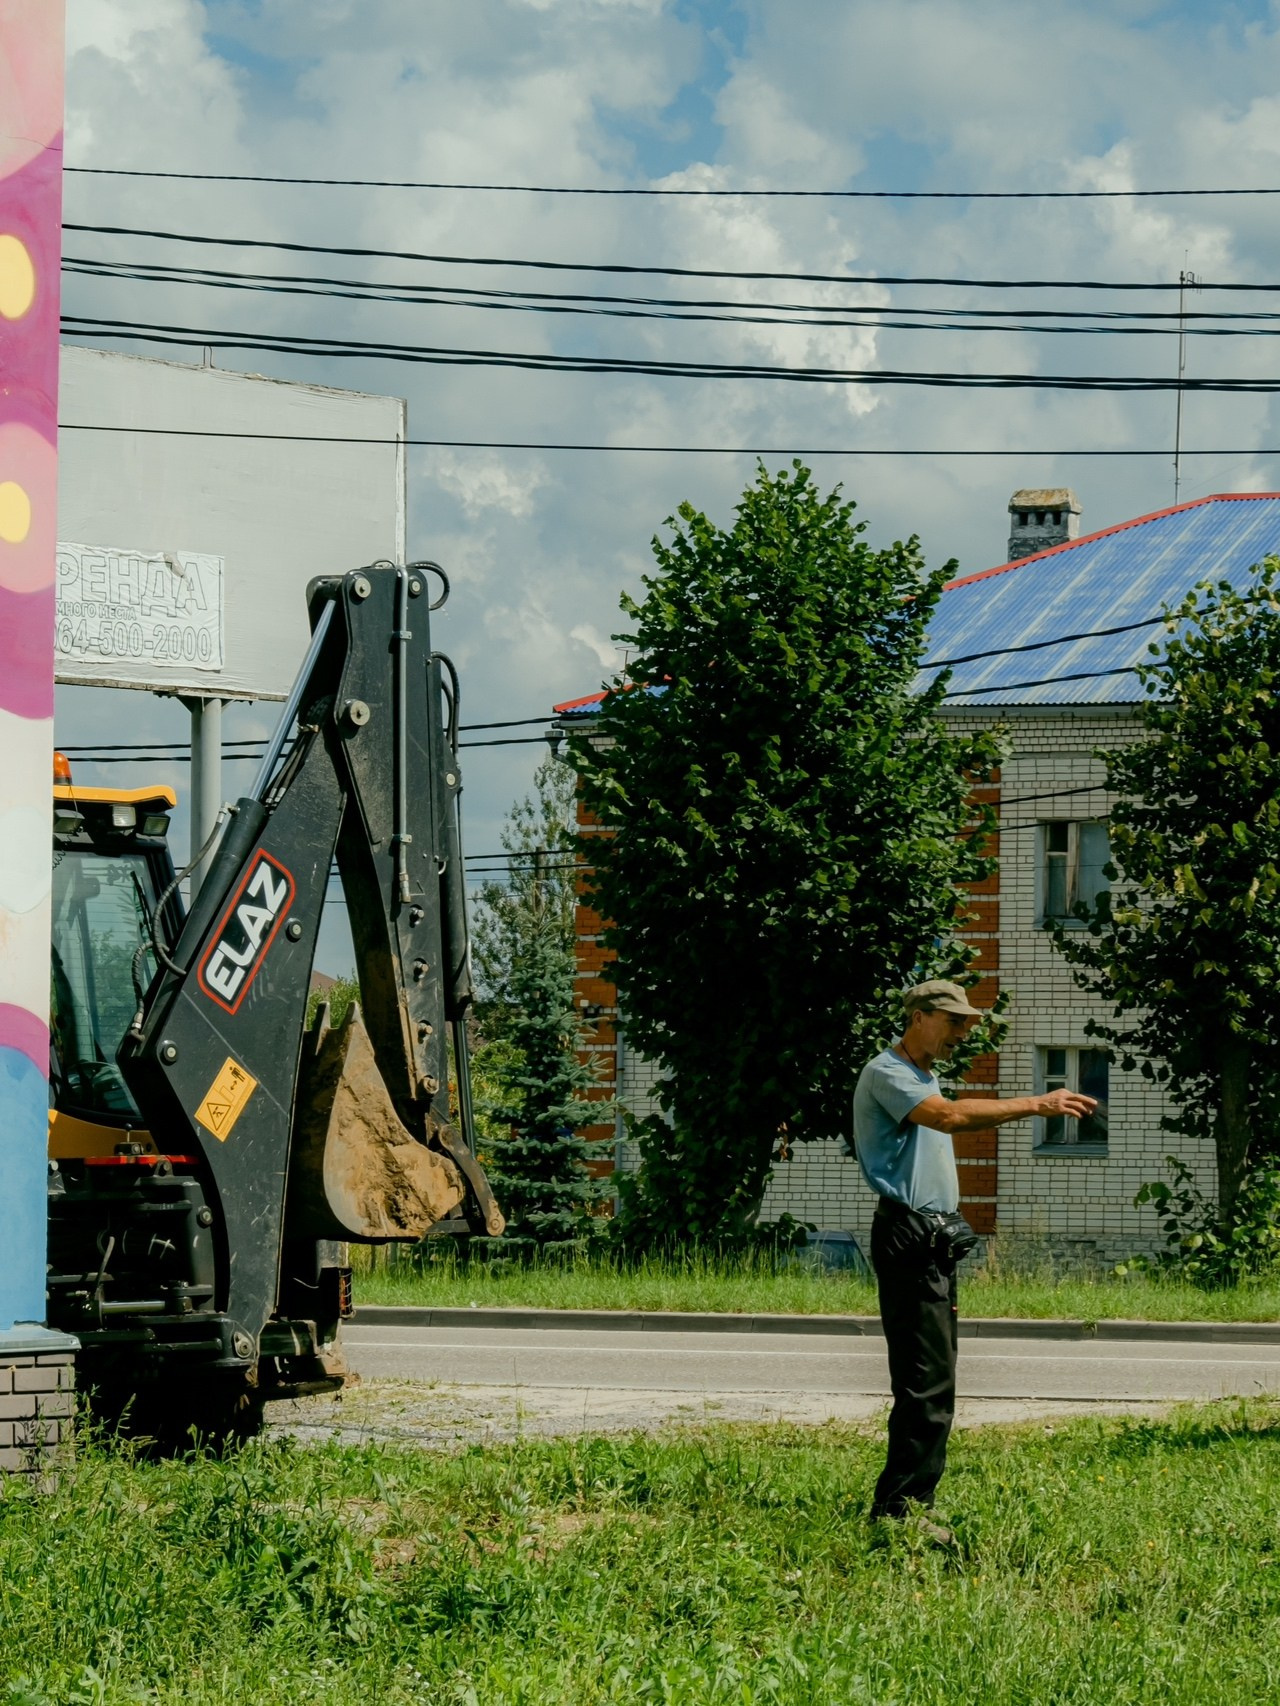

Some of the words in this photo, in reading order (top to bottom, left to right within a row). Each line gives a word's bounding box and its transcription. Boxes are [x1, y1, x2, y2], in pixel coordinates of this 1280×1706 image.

[98, 604, 137, 621] МЕСТА
[54, 616, 212, 662] 64-500-2000
[205, 861, 287, 1001] ELAZ
